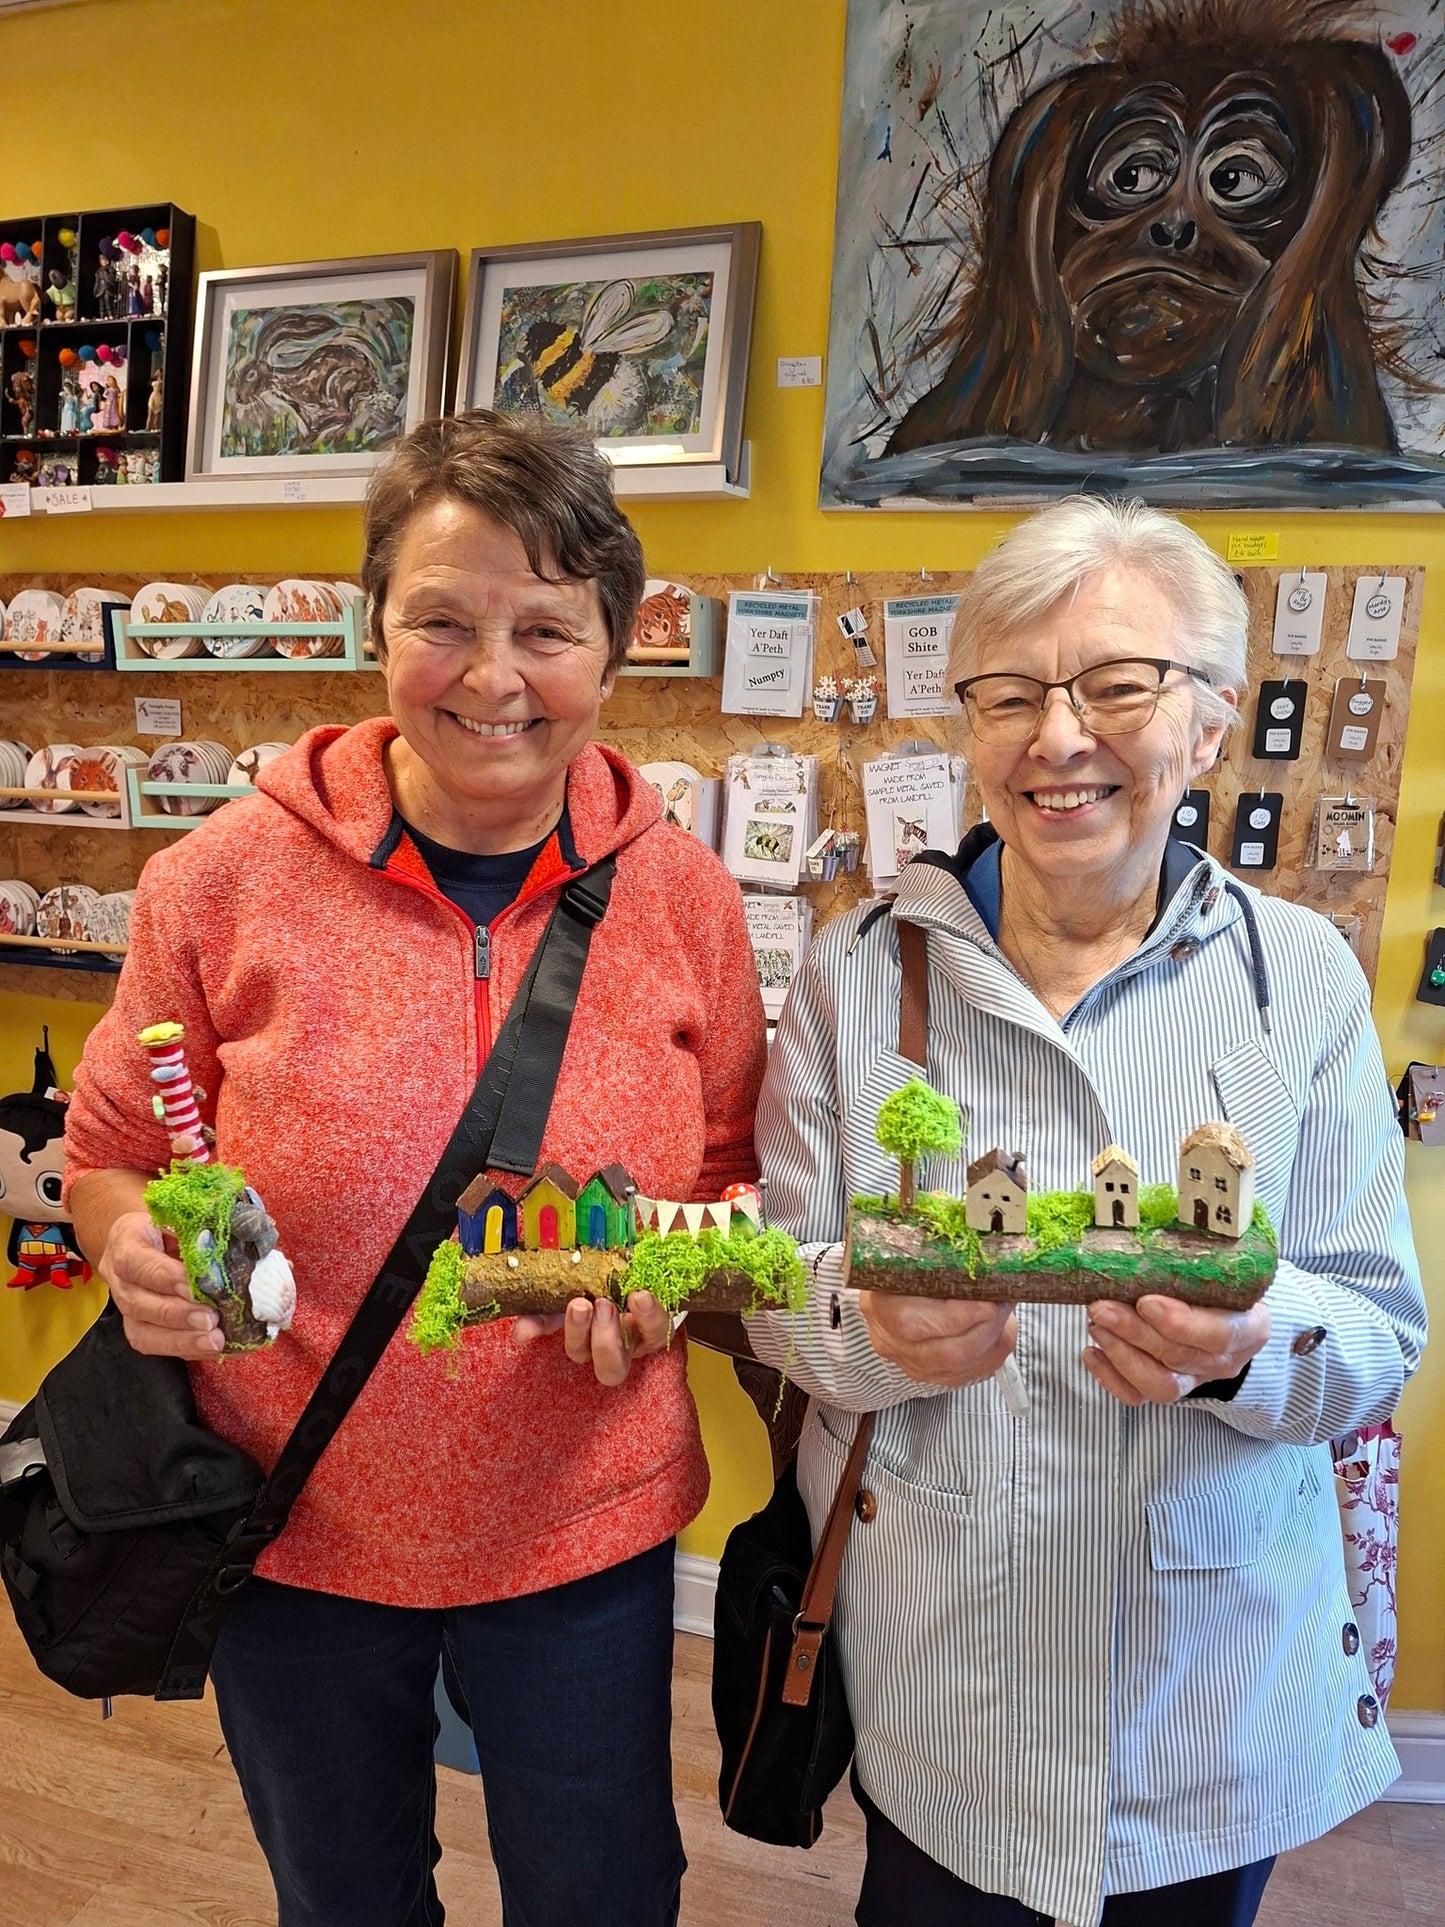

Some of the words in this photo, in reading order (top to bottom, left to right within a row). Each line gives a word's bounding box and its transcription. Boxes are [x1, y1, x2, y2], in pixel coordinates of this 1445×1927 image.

[51, 493, 79, 506] SALE
[896, 600, 929, 608] RECYCLED
[890, 607, 926, 616] YORKSHIRE
[750, 628, 766, 639] Yer
[769, 629, 788, 640] Daft
[909, 627, 938, 637] GOB
[752, 643, 783, 654] A'Peth
[908, 642, 938, 652] Shite
[748, 668, 785, 688] Numpty
[906, 670, 923, 680] Yer
[910, 684, 942, 694] A'Peth
[1351, 698, 1372, 706] Bugger
[868, 762, 901, 773] MAGNET
[884, 775, 904, 784] MADE
[906, 773, 927, 781] FROM
[868, 787, 895, 796] SAMPLE
[897, 784, 918, 793] METAL
[920, 781, 944, 790] SAVED
[879, 796, 899, 805] FROM
[900, 793, 934, 803] LANDFILL
[1326, 812, 1365, 821] MOOMIN
